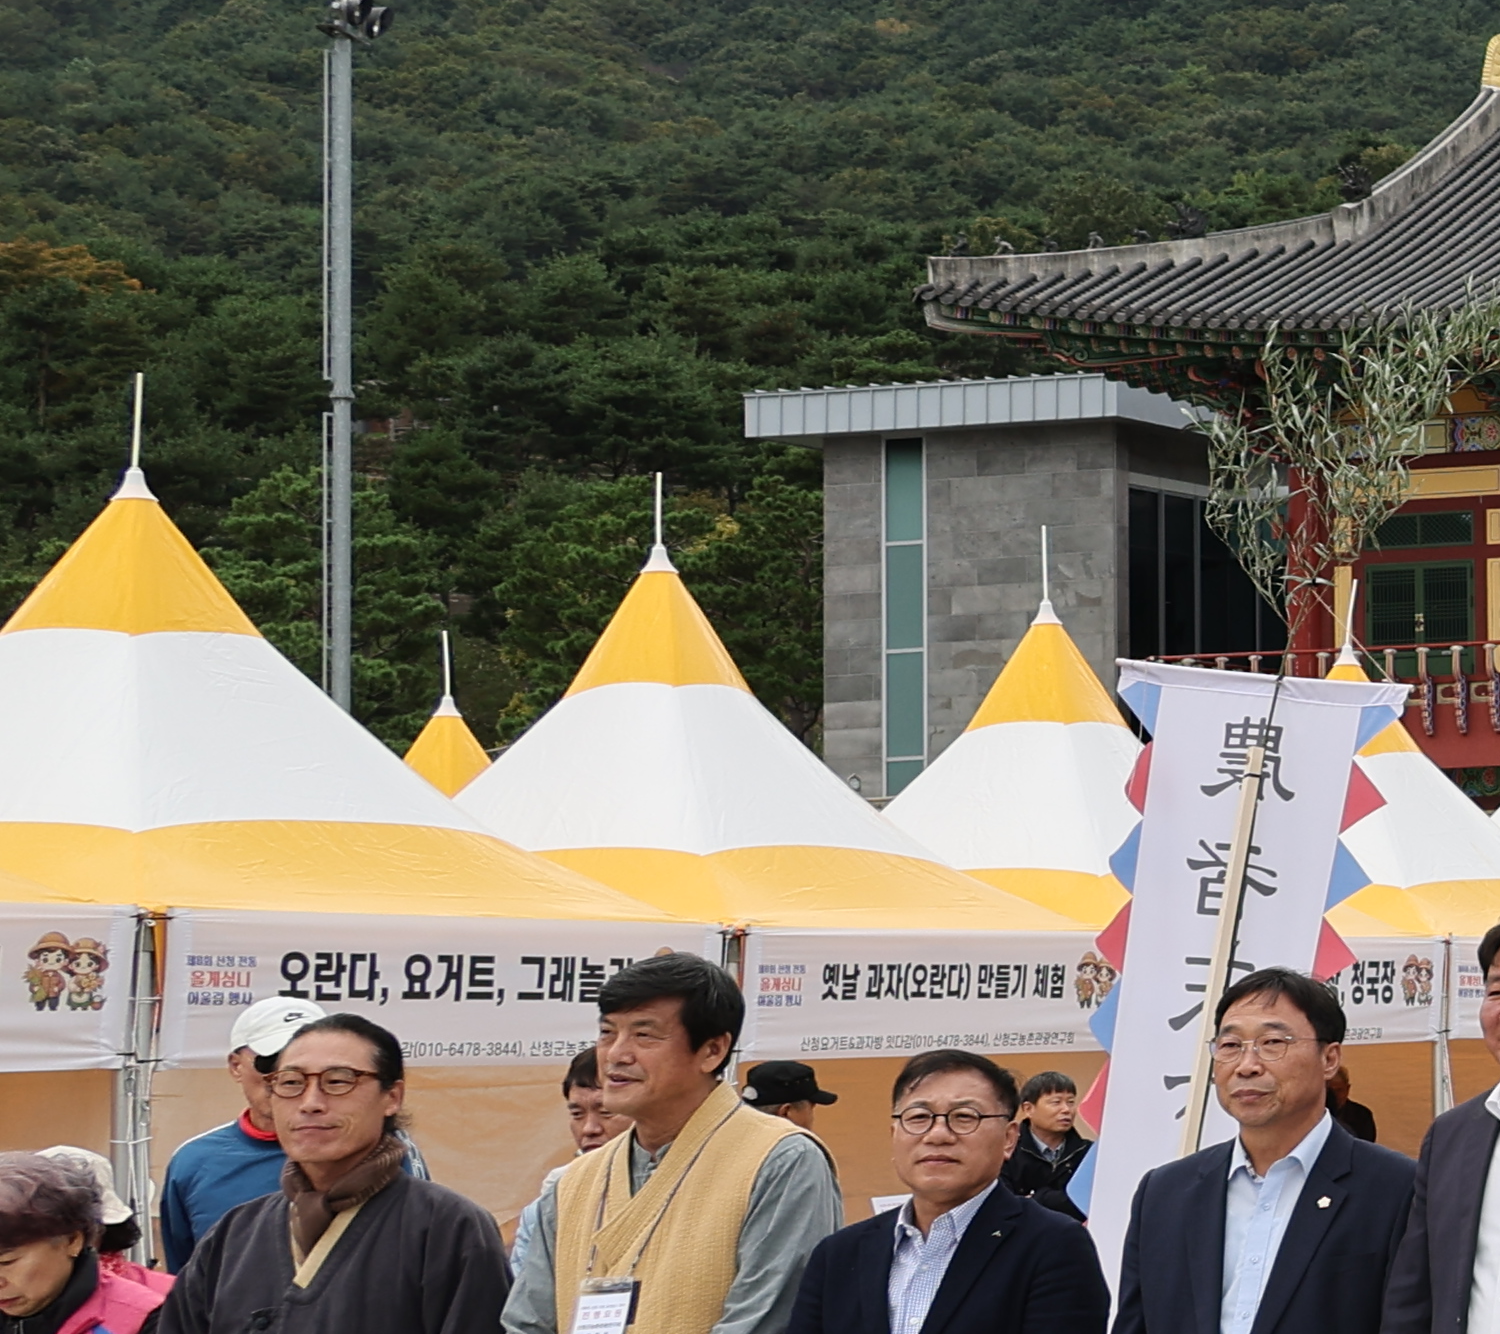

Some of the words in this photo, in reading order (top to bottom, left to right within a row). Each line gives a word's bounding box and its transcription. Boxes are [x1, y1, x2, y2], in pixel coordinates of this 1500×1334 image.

[190, 970, 251, 988] 올게심니
[278, 951, 389, 1005] 오란다,
[401, 954, 505, 1006] 요거트,
[760, 977, 802, 992] 올게심니
[821, 963, 861, 1001] 옛날
[866, 963, 971, 1001] 과자(오란다)
[977, 964, 1028, 999] 만들기
[1033, 963, 1066, 999] 체험
[1351, 960, 1396, 1005] 청국장
[187, 991, 224, 1006] 어울림
[228, 992, 253, 1005] 행사
